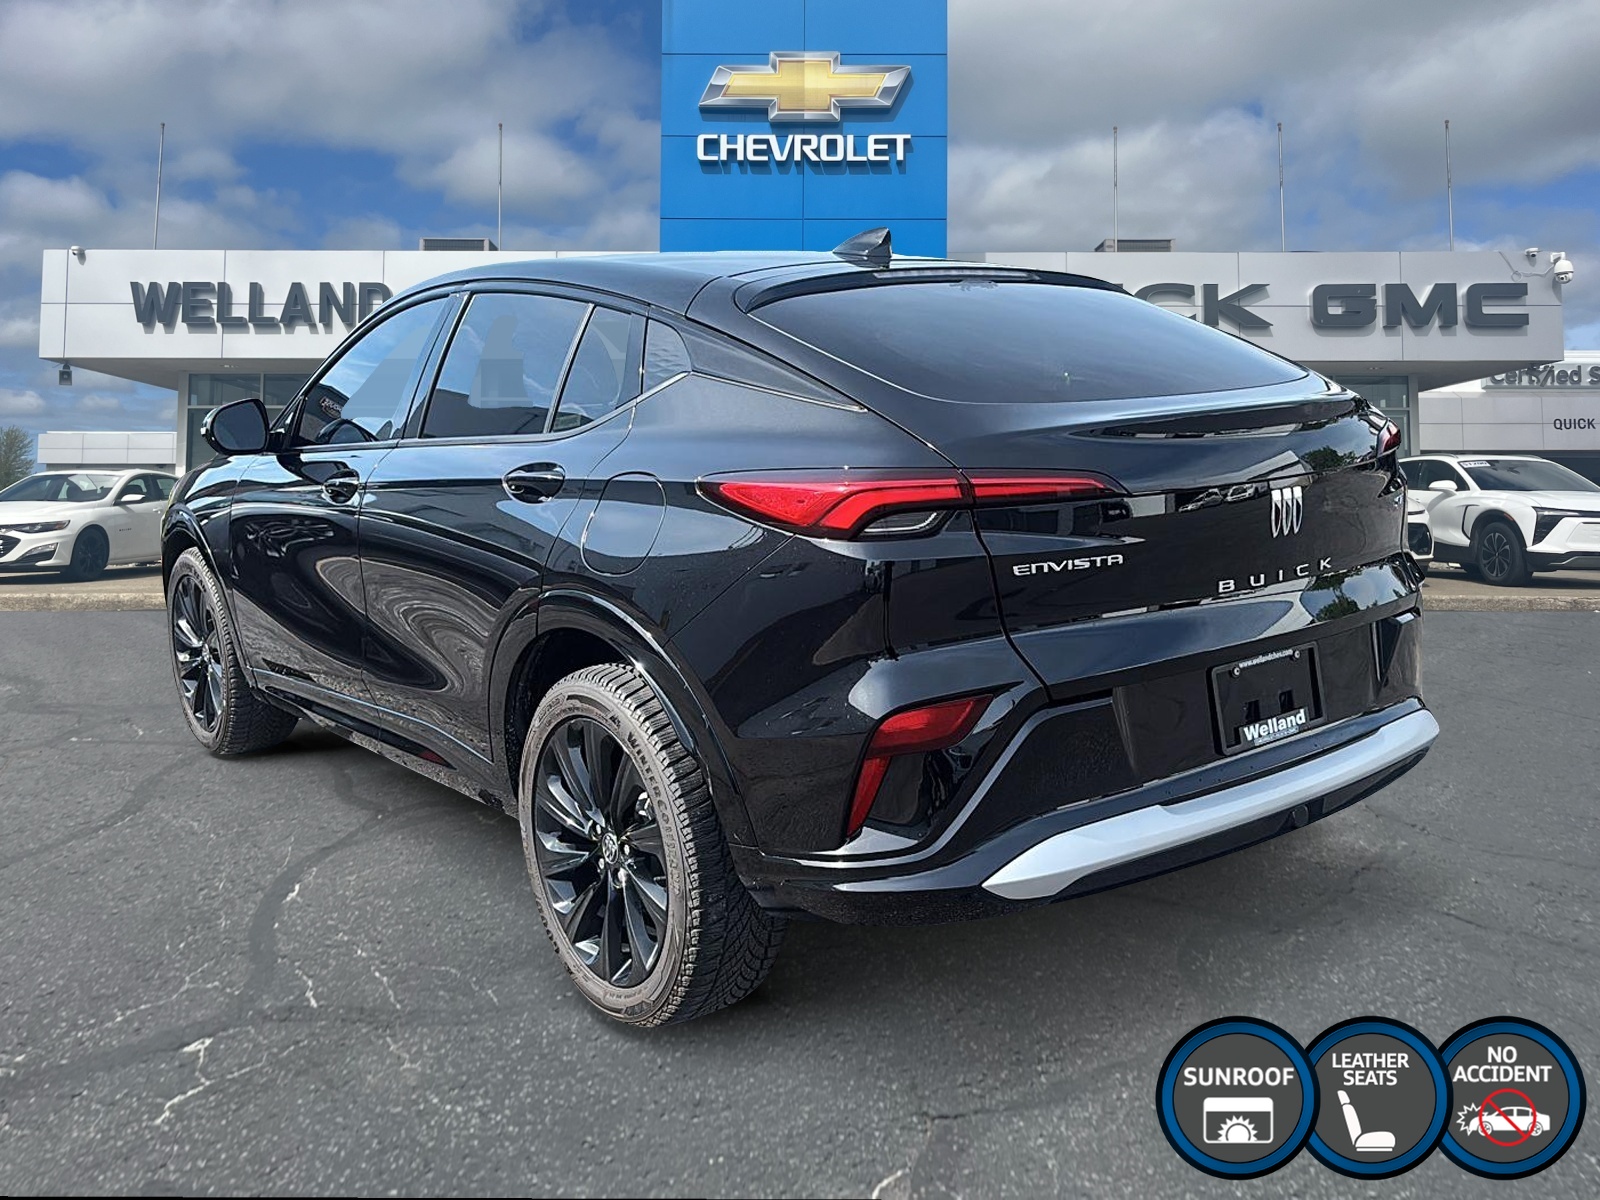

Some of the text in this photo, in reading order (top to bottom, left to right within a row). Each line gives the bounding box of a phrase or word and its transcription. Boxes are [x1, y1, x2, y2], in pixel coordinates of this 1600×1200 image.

[696, 134, 911, 161] CHEVROLET
[130, 281, 391, 324] WELLAND
[1114, 282, 1530, 328] CK GMC
[1490, 364, 1582, 385] Certiied
[1553, 418, 1596, 431] QUICK
[1013, 554, 1124, 576] ENVISTA
[1218, 557, 1332, 593] BUICK
[1243, 708, 1306, 741] Welland
